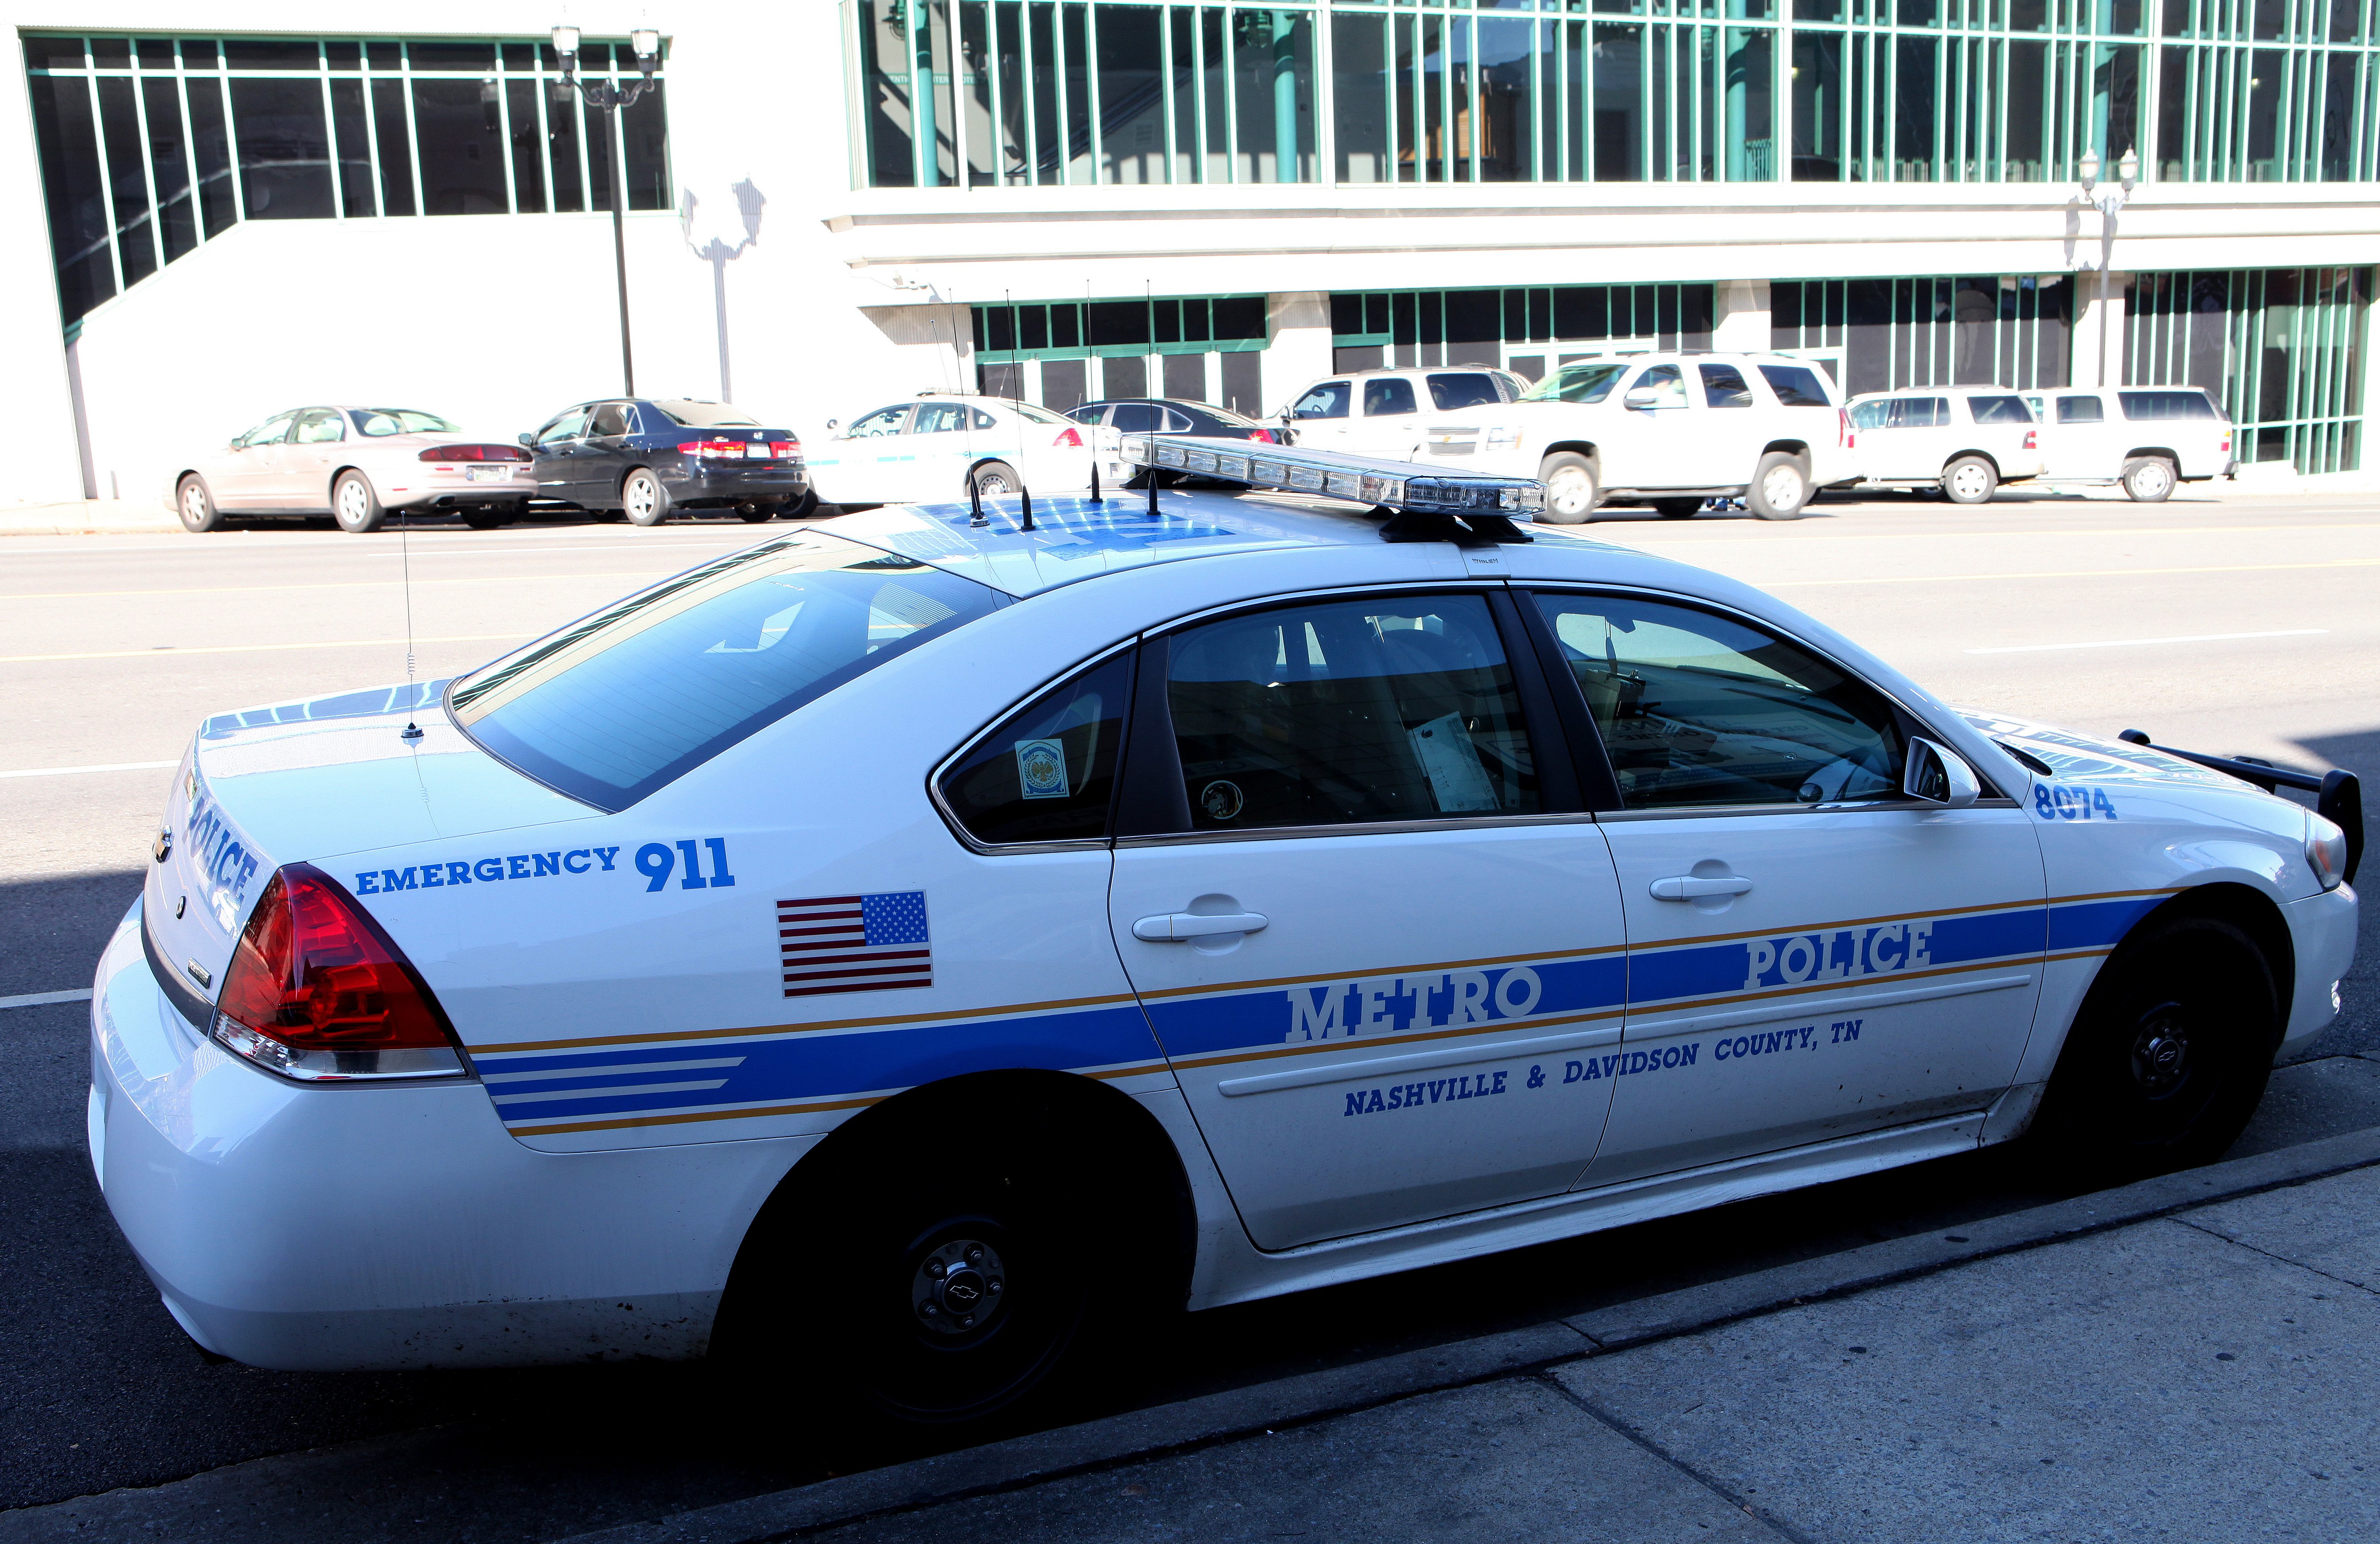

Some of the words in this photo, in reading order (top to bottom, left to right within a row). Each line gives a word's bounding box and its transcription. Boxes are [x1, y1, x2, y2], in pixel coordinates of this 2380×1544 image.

[2035, 783, 2118, 820] 8074
[182, 795, 259, 912] POLICE
[356, 846, 620, 896] EMERGENCY
[634, 837, 735, 893] 911
[1286, 966, 1542, 1044] METRO
[1744, 921, 1933, 990] POLICE
[1344, 1070, 1508, 1116] NASHVILLE
[1527, 1065, 1546, 1089] &
[1562, 1043, 1699, 1084] DAVIDSON
[1714, 1024, 1819, 1060] COUNTY,
[1831, 1020, 1863, 1043] TN
